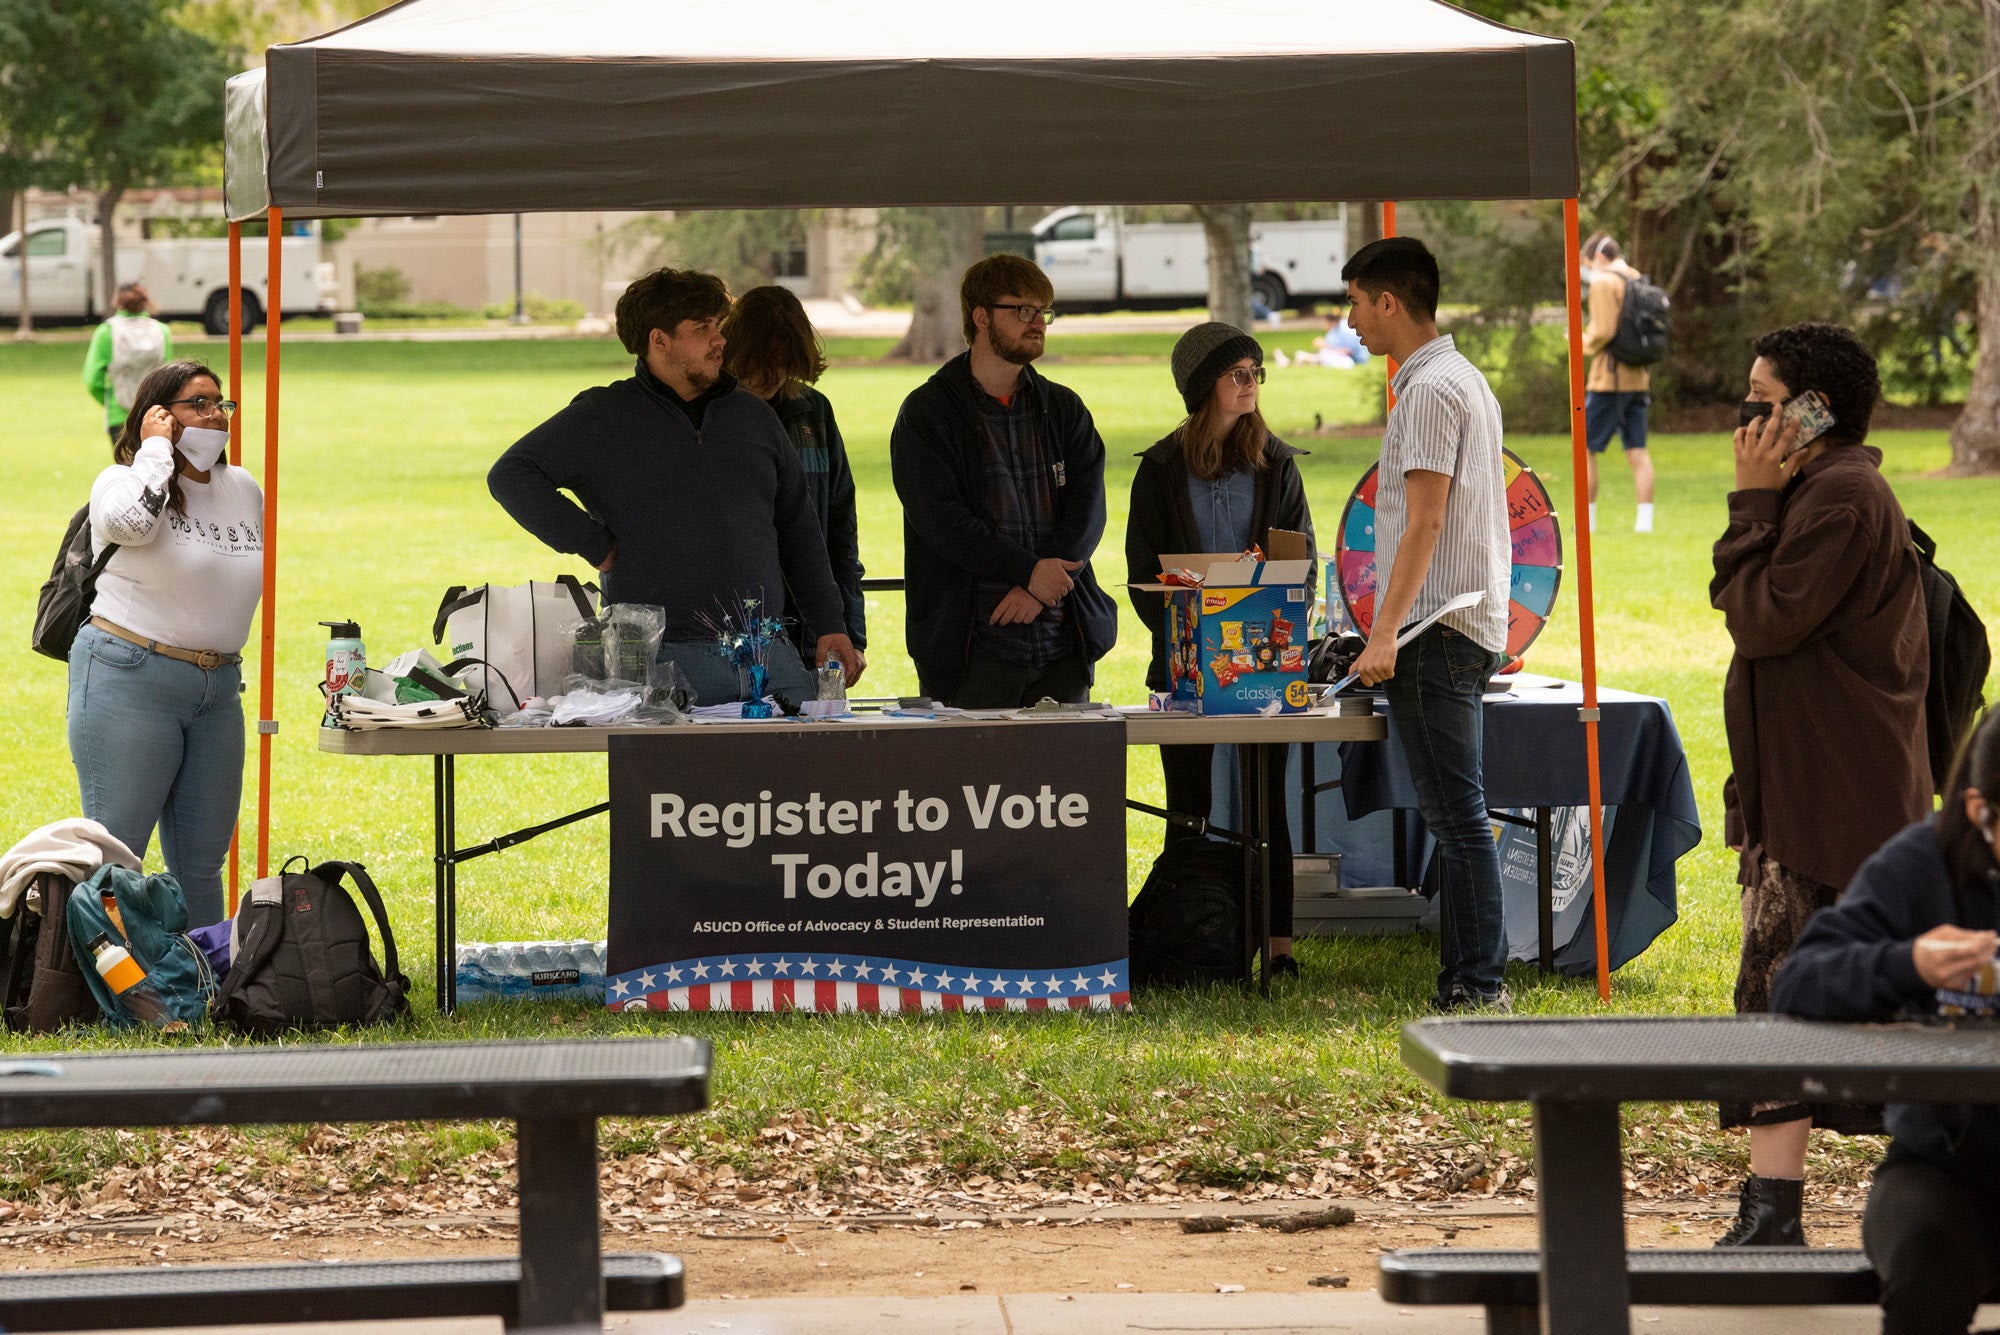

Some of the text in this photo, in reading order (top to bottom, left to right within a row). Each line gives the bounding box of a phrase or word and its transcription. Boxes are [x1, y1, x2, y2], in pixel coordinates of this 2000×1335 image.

[1236, 686, 1283, 700] classic
[1290, 684, 1305, 699] 54
[650, 785, 1089, 848] Register to Vote
[771, 849, 963, 907] Today!
[693, 915, 1045, 933] ASUCD Office of Advocacy & Student Representation
[534, 971, 578, 981] KIRKLAND
